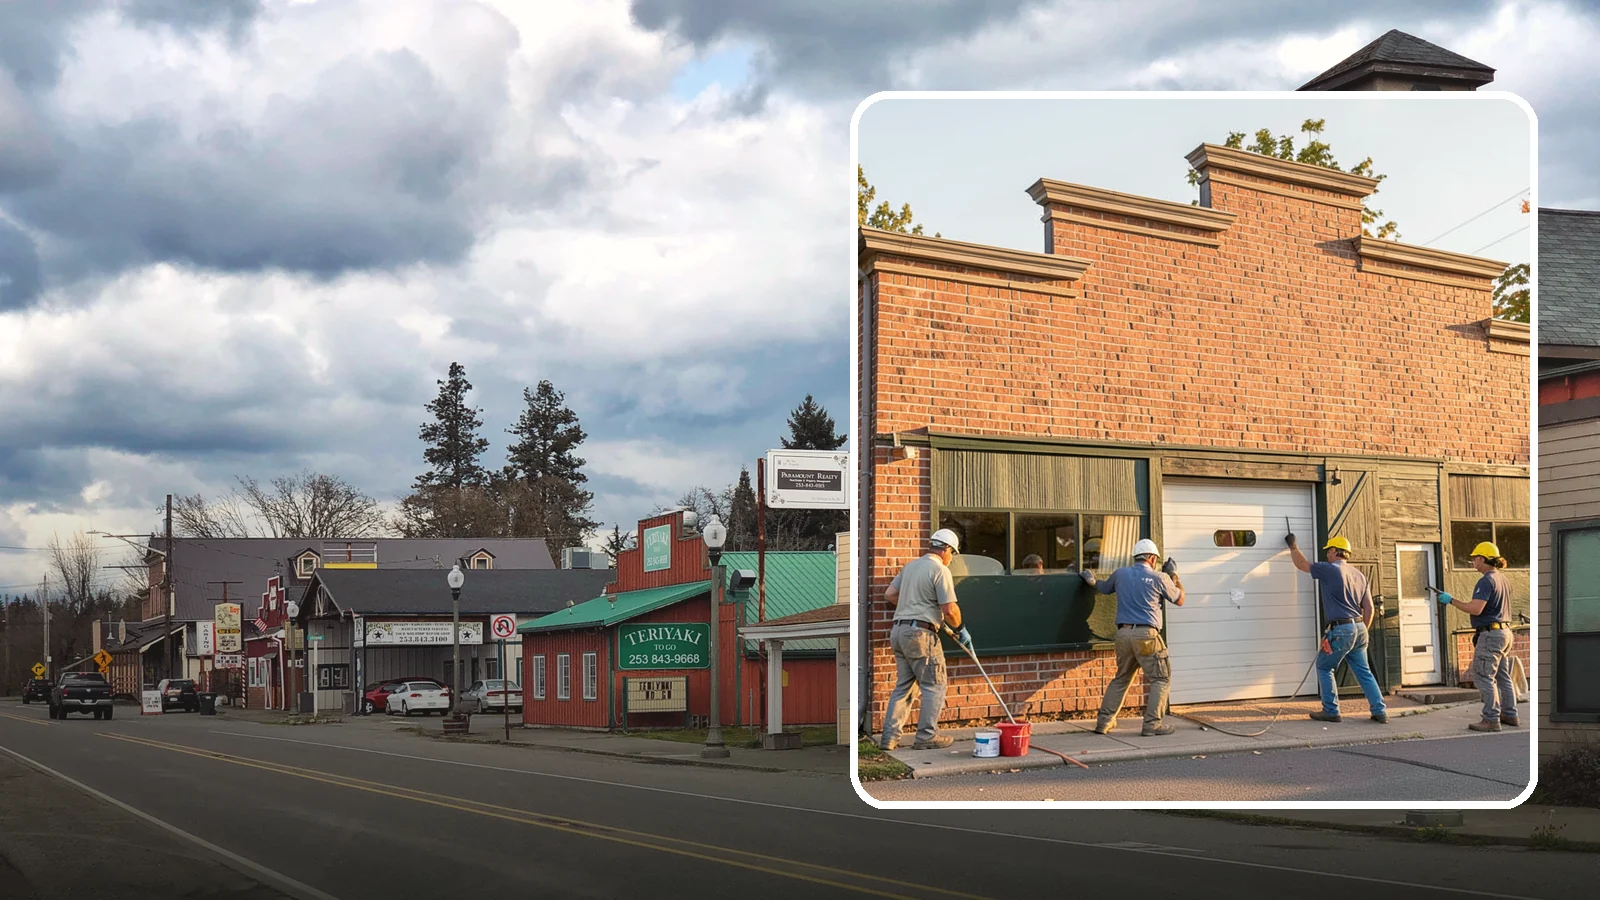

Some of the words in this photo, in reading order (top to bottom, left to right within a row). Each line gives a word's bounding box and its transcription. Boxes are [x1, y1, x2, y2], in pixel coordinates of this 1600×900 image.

[781, 471, 815, 479] PARAMOUNT
[817, 472, 838, 480] REALTY
[624, 627, 703, 646] TERIYAKI
[653, 643, 664, 651] TO
[665, 643, 677, 651] GO
[628, 654, 649, 665] 253
[651, 653, 700, 664] 843-9668
